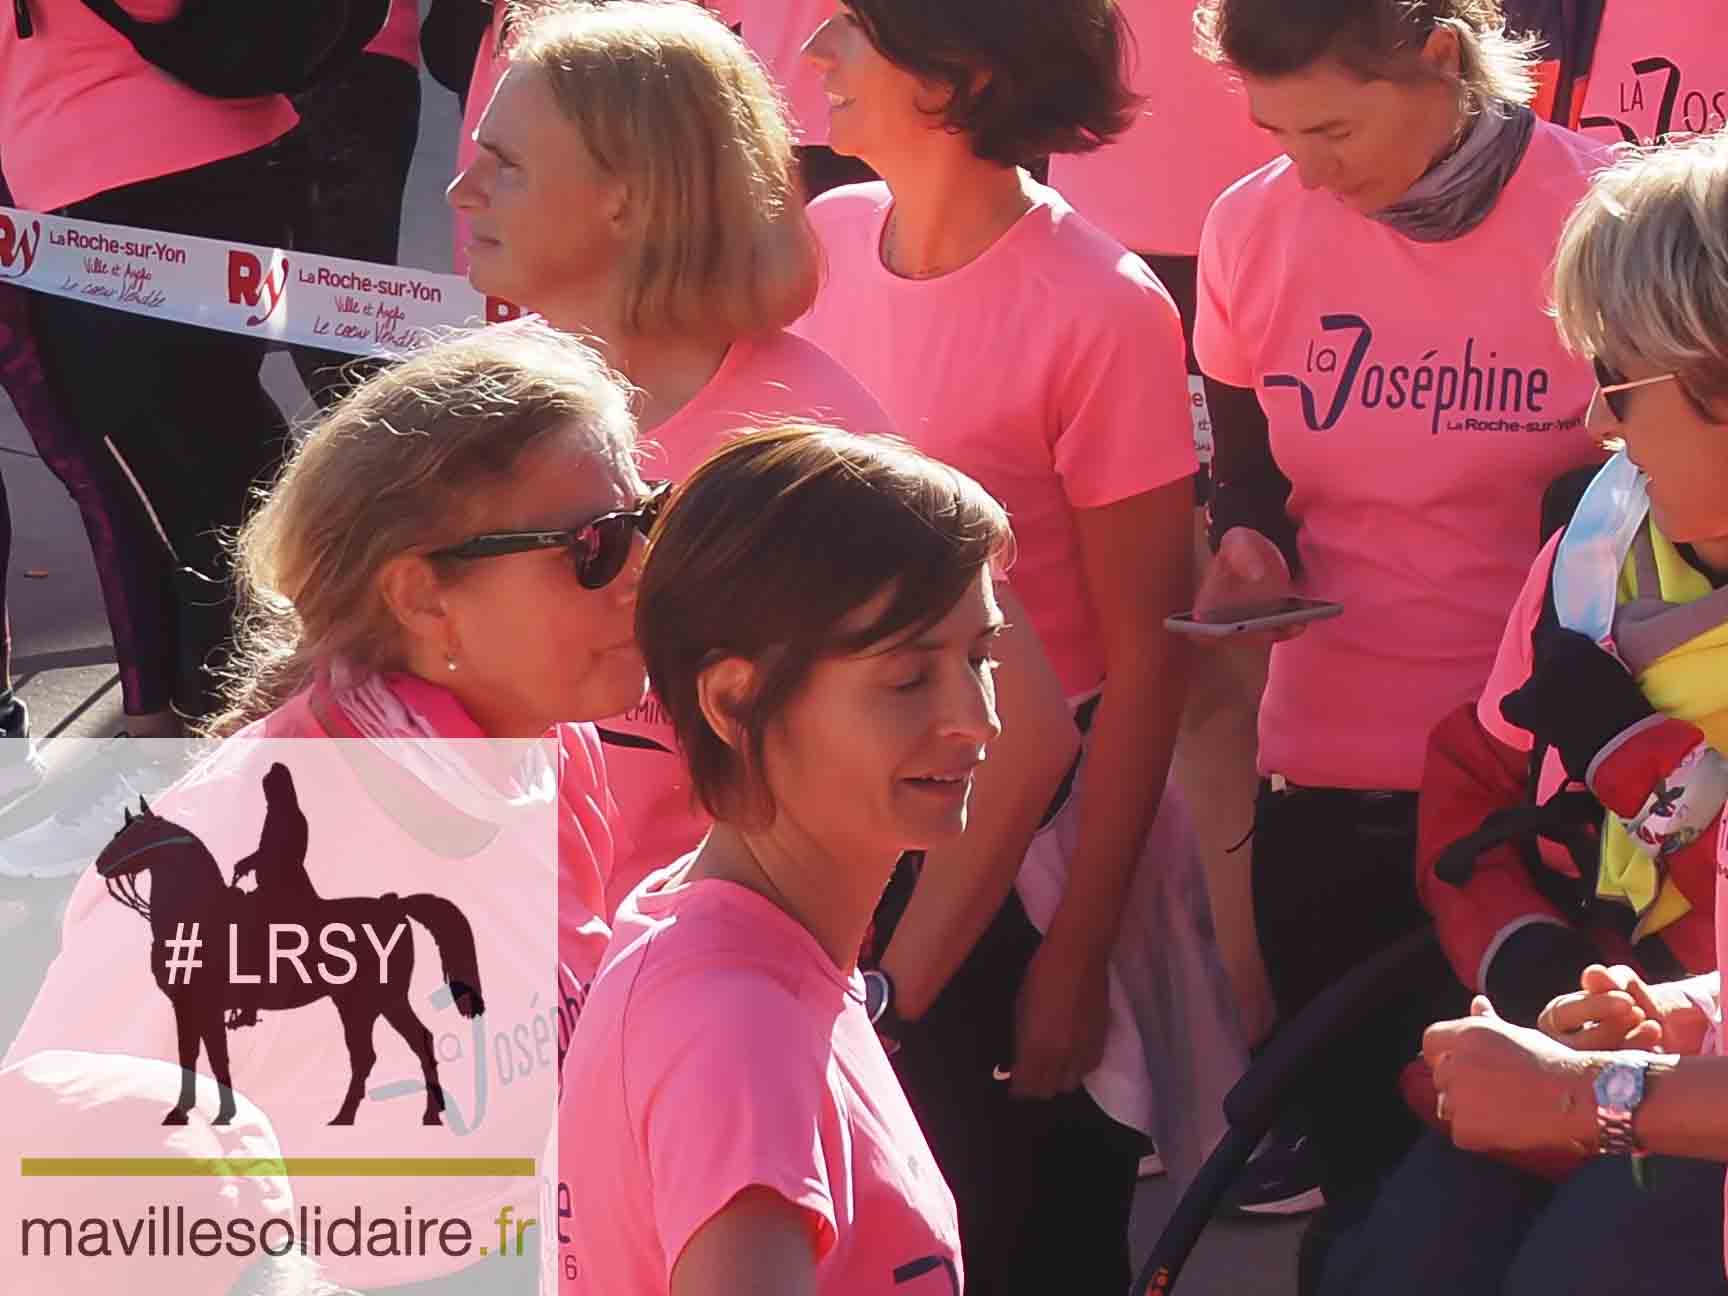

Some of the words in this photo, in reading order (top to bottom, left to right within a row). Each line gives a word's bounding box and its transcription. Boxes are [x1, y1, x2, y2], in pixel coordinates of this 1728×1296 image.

[1619, 80, 1644, 114] LA
[49, 228, 66, 247] La
[67, 227, 187, 266] Roche-sur-Yon
[83, 255, 108, 276] Ville
[298, 267, 315, 284] La
[316, 266, 443, 305] Roche-sur-Yon
[334, 293, 360, 315] Ville
[1306, 339, 1337, 373] la
[1263, 313, 1549, 435] Joséphine
[1446, 420, 1465, 431] La
